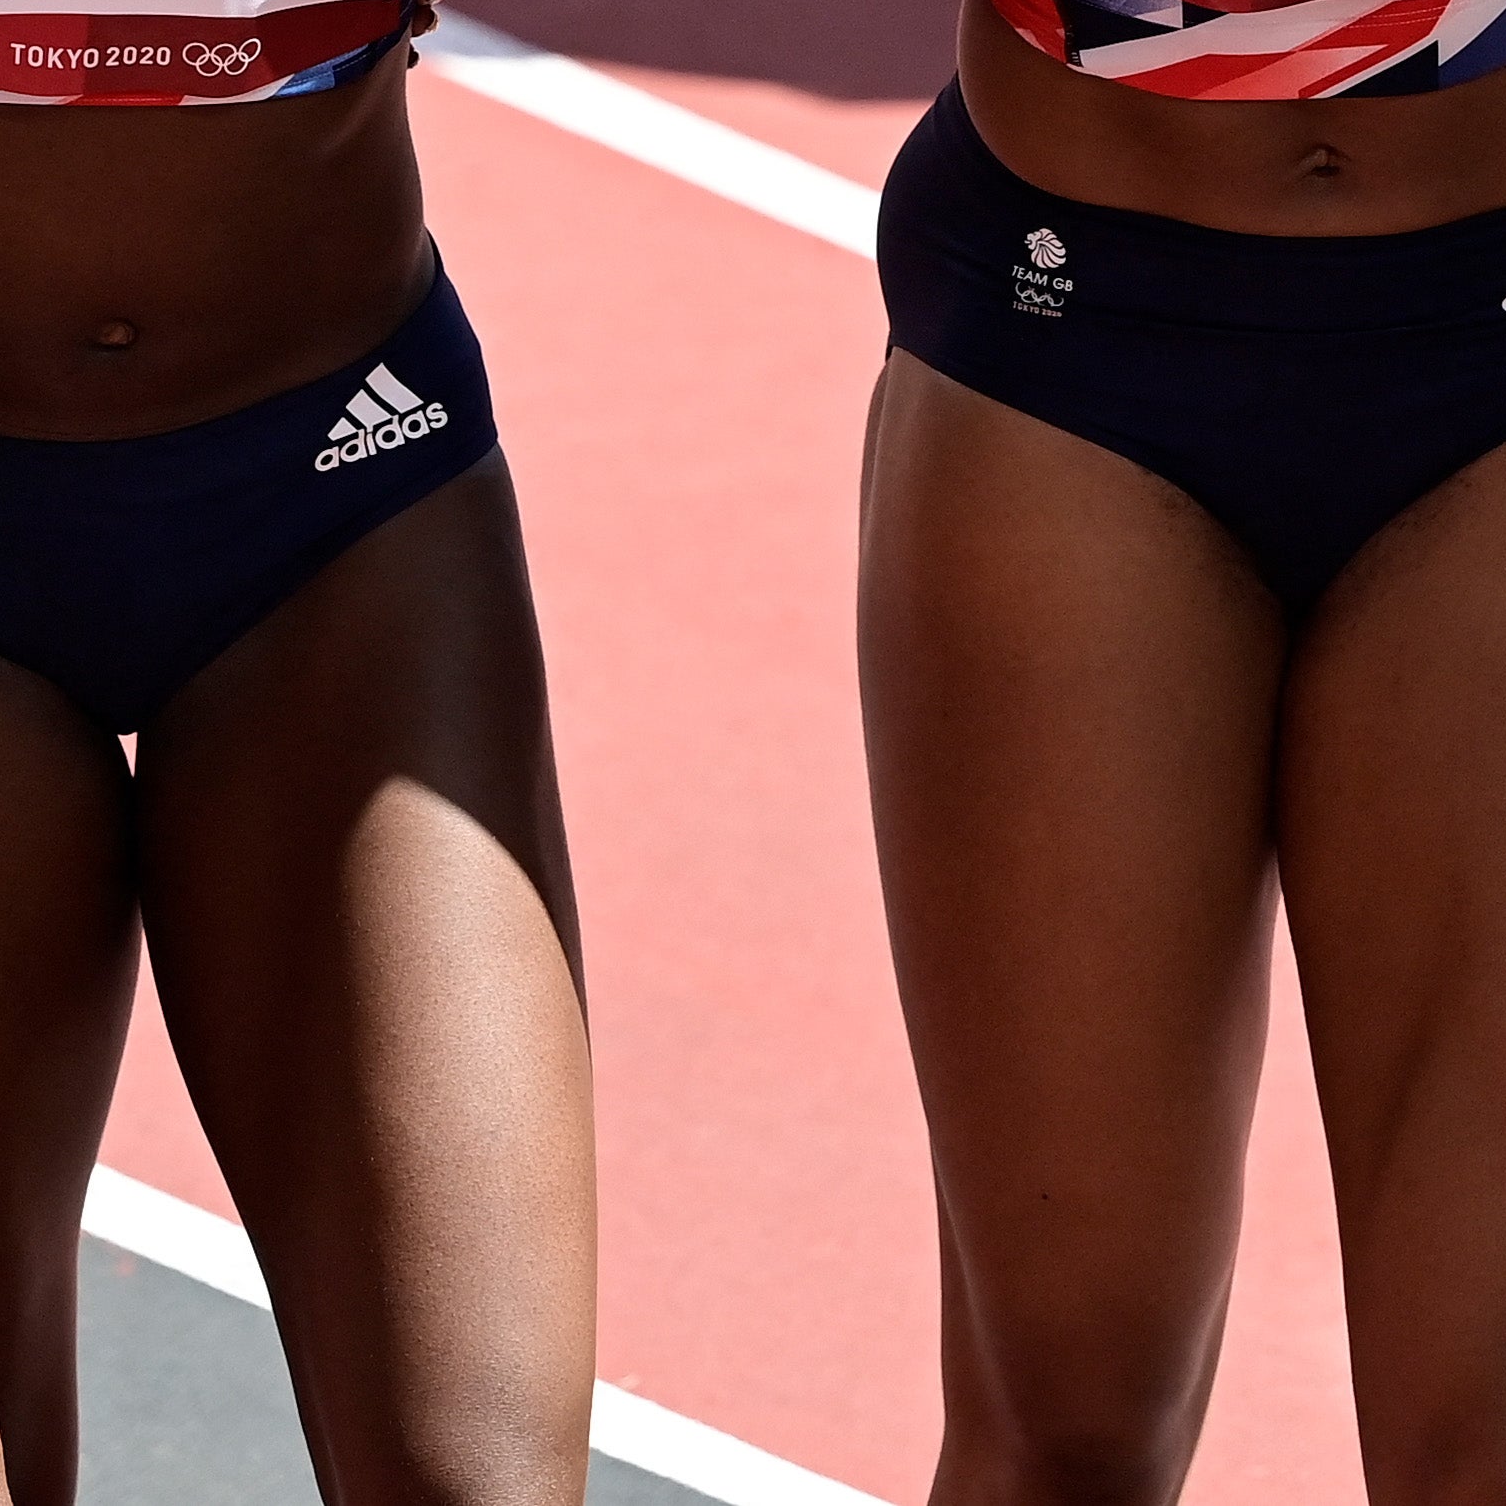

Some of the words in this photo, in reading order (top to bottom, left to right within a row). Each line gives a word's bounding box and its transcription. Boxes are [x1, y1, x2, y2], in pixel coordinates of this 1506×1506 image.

[10, 42, 100, 70] TOKYO
[105, 45, 172, 67] 2020
[1011, 265, 1049, 287] TEAM
[1052, 277, 1073, 292] GB
[314, 401, 449, 472] adidas
